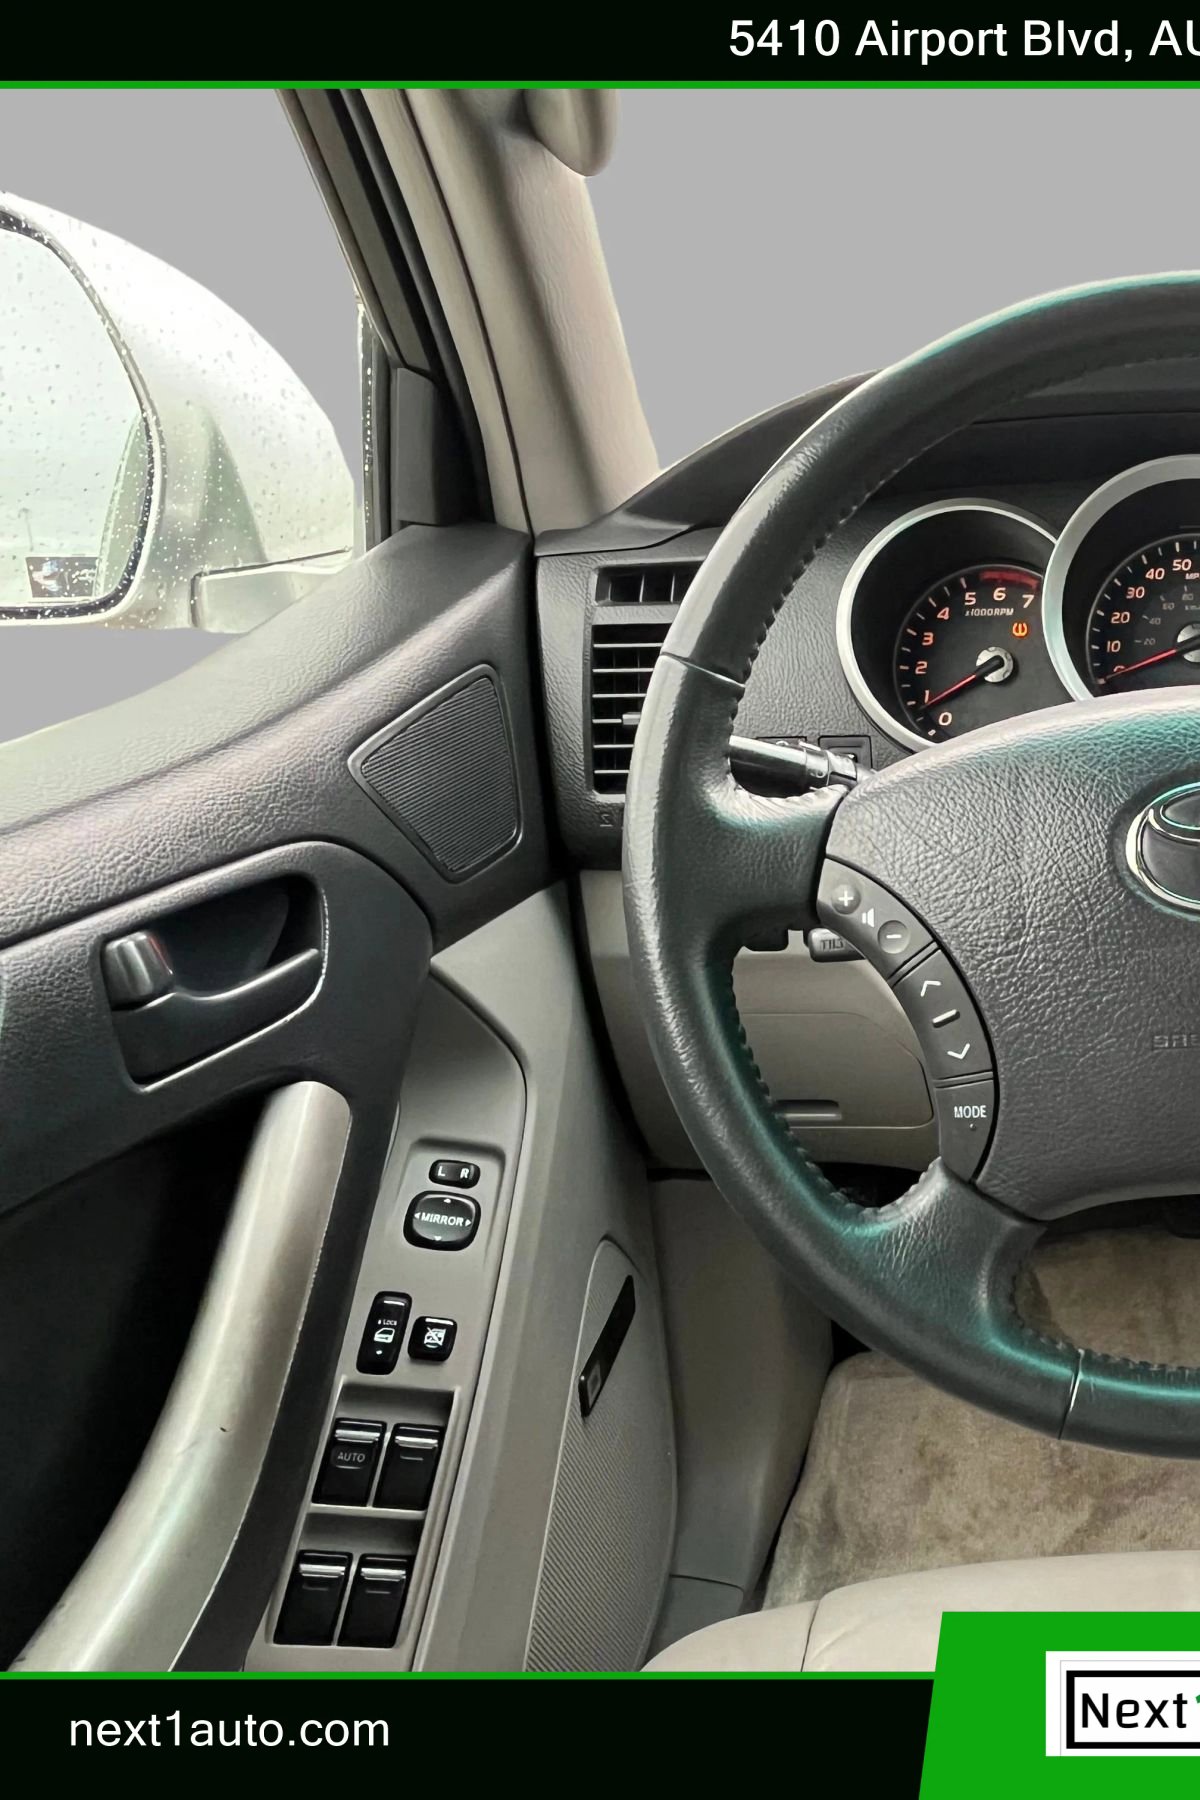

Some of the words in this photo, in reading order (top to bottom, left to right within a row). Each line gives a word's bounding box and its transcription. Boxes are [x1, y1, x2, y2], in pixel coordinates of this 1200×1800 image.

[1172, 558, 1192, 571] 50
[1145, 568, 1165, 580] 40
[965, 592, 976, 605] 5
[993, 587, 1006, 600] 6
[1126, 586, 1145, 599] 30
[1022, 594, 1035, 608] 7
[937, 607, 950, 620] 4
[1111, 612, 1130, 624] 20
[922, 632, 934, 645] 3
[1106, 640, 1121, 653] 10
[915, 661, 928, 674] 2
[924, 689, 930, 703] 1
[938, 712, 952, 725] 0
[954, 1105, 987, 1119] MODE
[437, 1166, 446, 1177] L
[460, 1168, 470, 1179] R
[420, 1212, 464, 1227] MIRROR
[337, 1451, 366, 1463] AUTO
